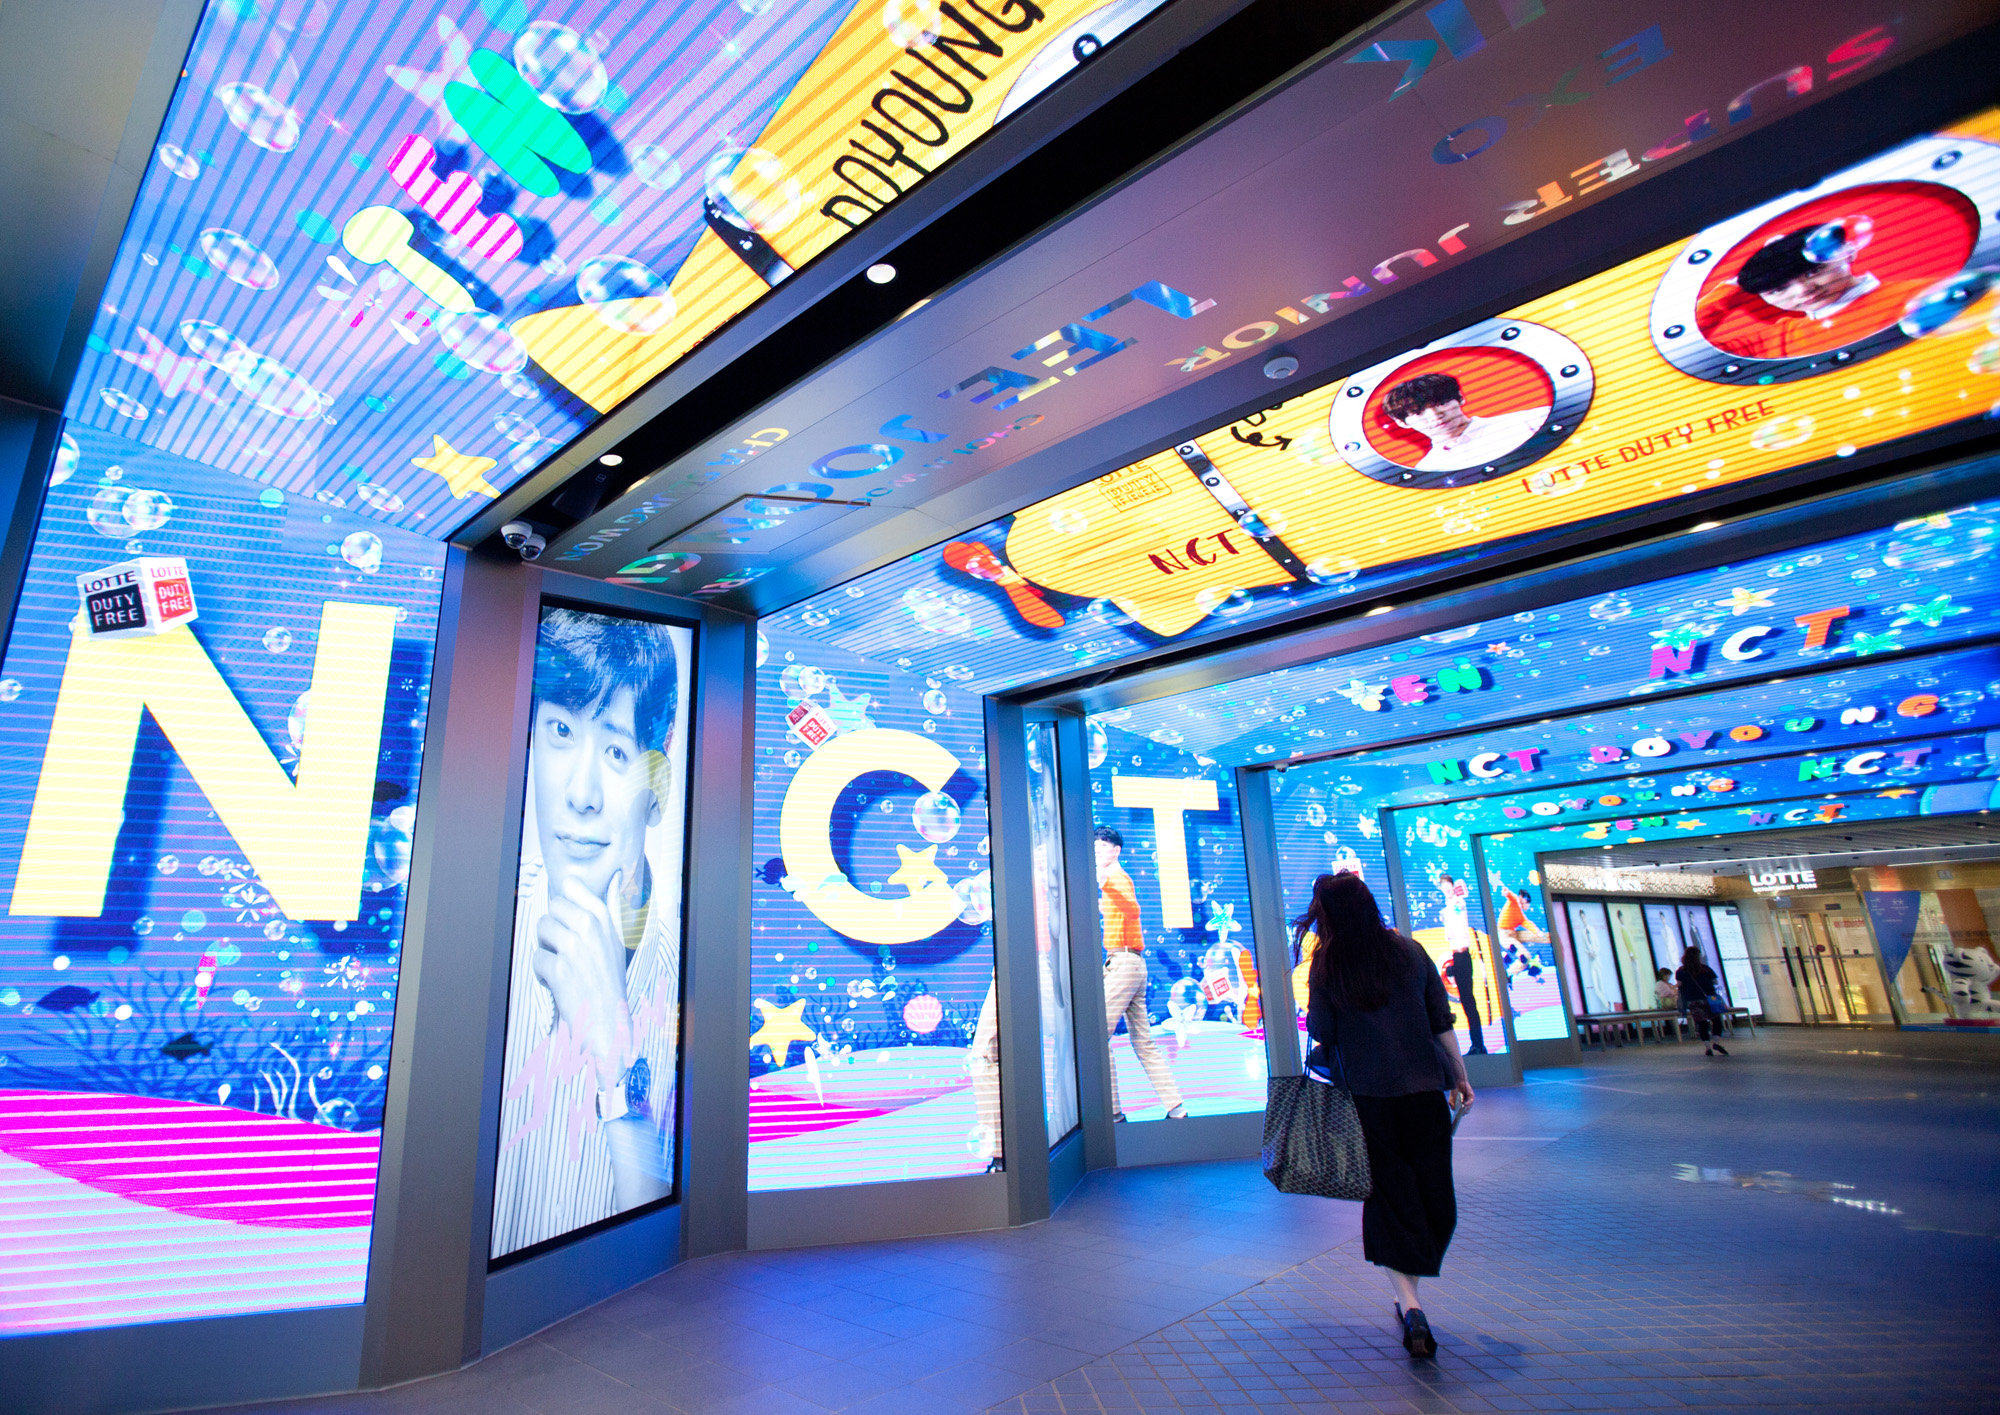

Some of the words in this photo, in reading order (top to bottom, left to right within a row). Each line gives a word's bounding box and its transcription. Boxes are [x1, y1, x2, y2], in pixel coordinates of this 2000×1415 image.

[1431, 23, 1674, 165] EXO
[937, 280, 1217, 411] LEE
[1618, 422, 1694, 464] DUTY
[1706, 398, 1775, 436] FREE
[1107, 473, 1155, 500] DUTY
[1148, 528, 1240, 575] NCT
[84, 570, 137, 593] LOTTE
[150, 566, 186, 578] LOTTE
[91, 592, 136, 613] DUTY
[158, 583, 187, 600] DUTY
[94, 608, 140, 627] FREE
[161, 596, 190, 615] FREE
[1649, 606, 1851, 679] NCT
[1426, 747, 1540, 785] NCT
[1590, 694, 1940, 764] DOYOUNG
[9, 600, 398, 922] N
[1798, 747, 1933, 782] NCT
[1748, 803, 1845, 825] NCT
[1749, 870, 1817, 886] LOTTE
